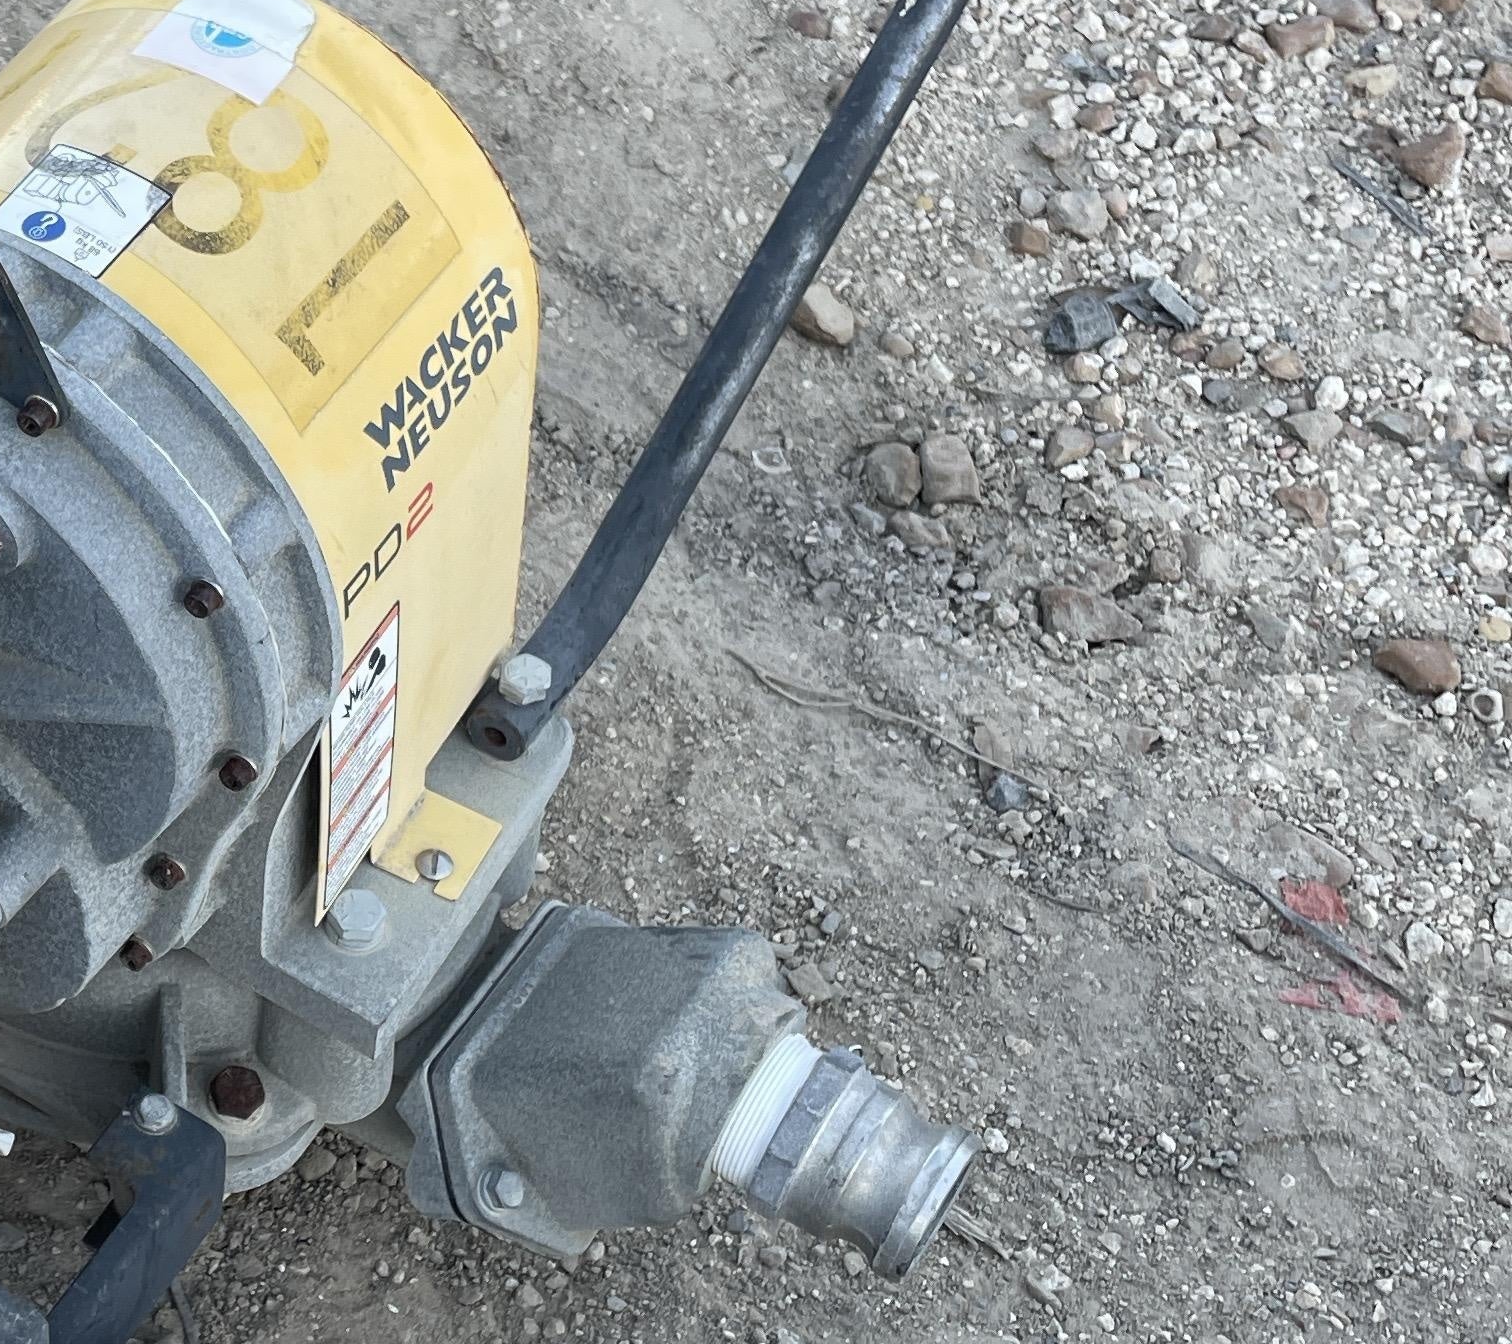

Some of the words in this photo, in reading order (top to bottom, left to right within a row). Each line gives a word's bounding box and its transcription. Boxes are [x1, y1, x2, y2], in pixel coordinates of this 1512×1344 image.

[362, 265, 511, 449] WACKER
[380, 297, 520, 493] NEUSON
[342, 481, 435, 622] PD2
